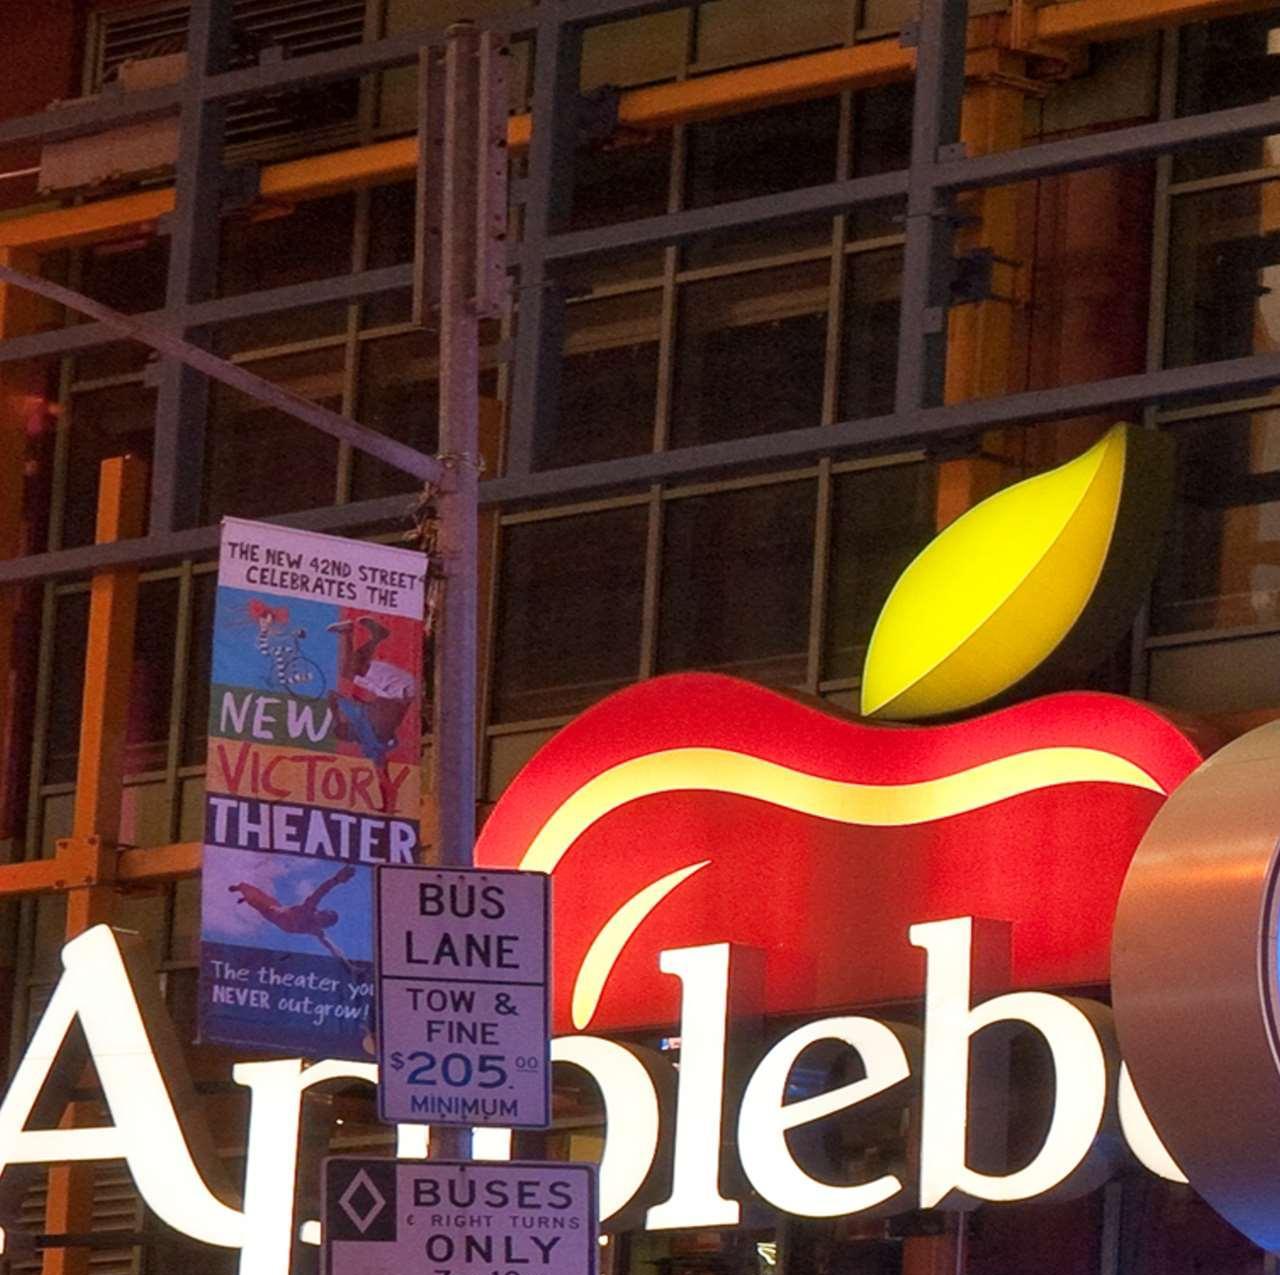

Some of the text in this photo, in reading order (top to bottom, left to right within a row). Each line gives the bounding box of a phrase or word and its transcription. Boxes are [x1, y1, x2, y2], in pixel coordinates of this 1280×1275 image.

[228, 542, 260, 563] THE
[265, 548, 303, 569] NEW
[309, 557, 351, 578] 42ND
[246, 565, 398, 608] CELEBRATES THE
[219, 691, 333, 742] NEW
[217, 742, 411, 814] VICTORY
[209, 797, 417, 864] THEATER
[419, 883, 506, 919] BUS
[405, 930, 519, 969] LANE
[211, 960, 250, 982] The
[257, 966, 341, 992] theater
[212, 984, 370, 1026] NEVER outgrow!
[406, 988, 519, 1016] TOW &
[426, 1020, 499, 1045] FINE
[410, 1095, 519, 1117] MINIMUM
[413, 1178, 573, 1210] BUSES
[431, 1214, 493, 1228] RIGHT
[510, 1215, 580, 1229] TURNS
[425, 1233, 561, 1264] ONLY
